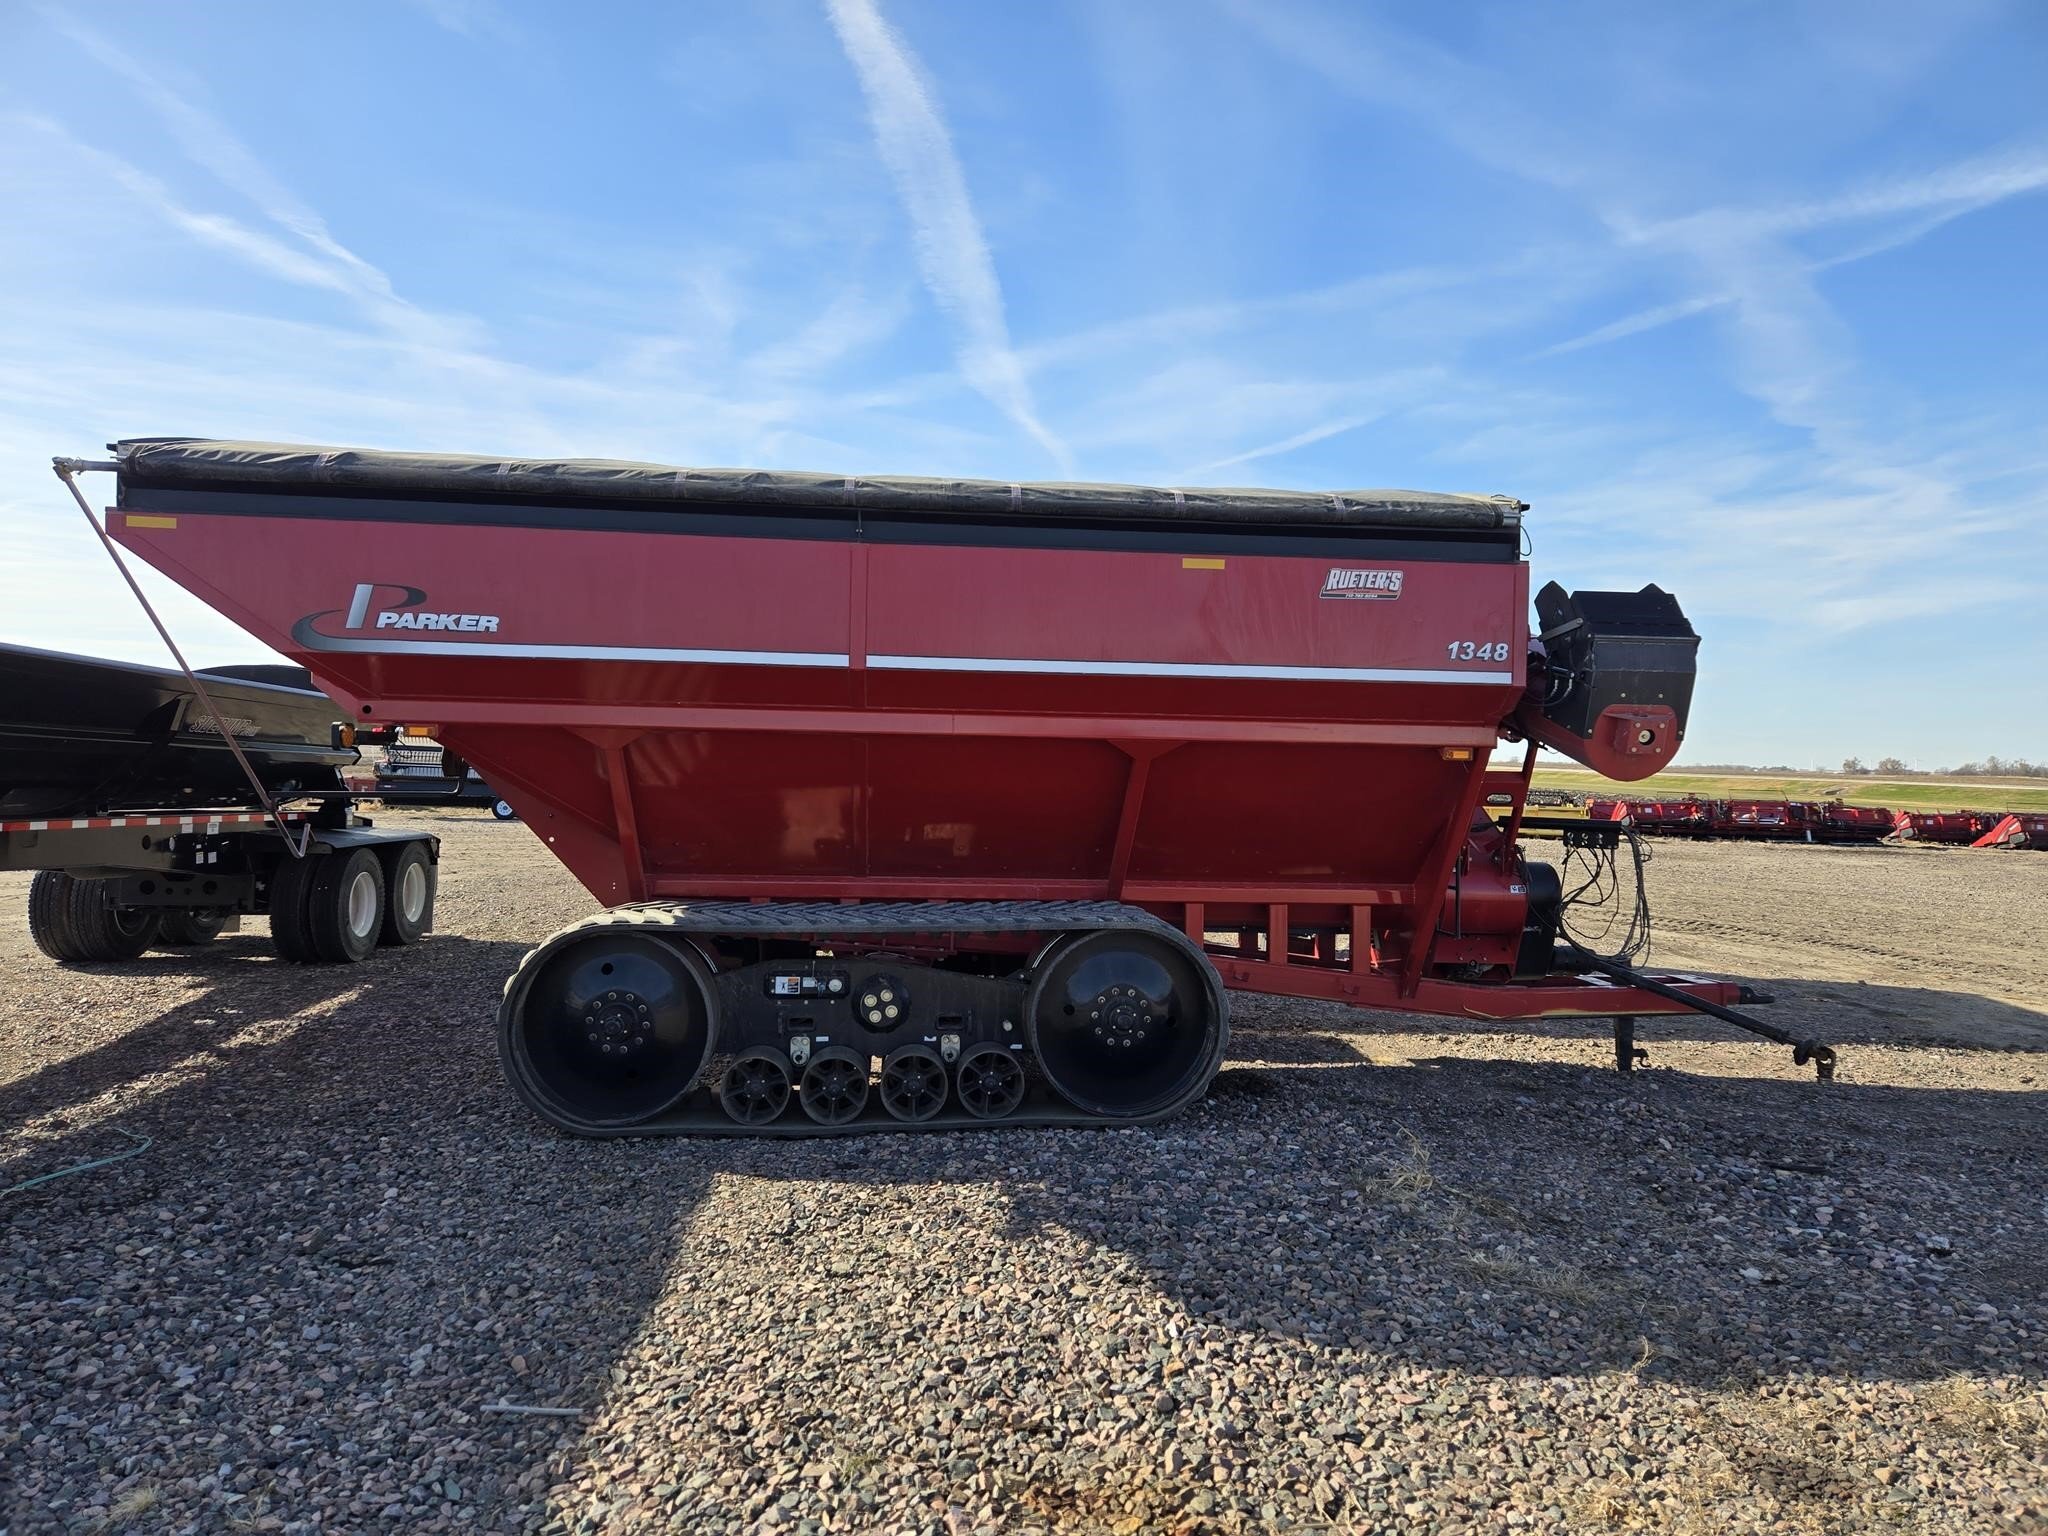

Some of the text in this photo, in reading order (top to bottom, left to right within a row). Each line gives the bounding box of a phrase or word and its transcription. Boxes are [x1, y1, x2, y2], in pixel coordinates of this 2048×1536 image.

[1326, 569, 1402, 592] RUETER'S
[375, 612, 500, 633] PARKER
[1447, 641, 1509, 661] 1348
